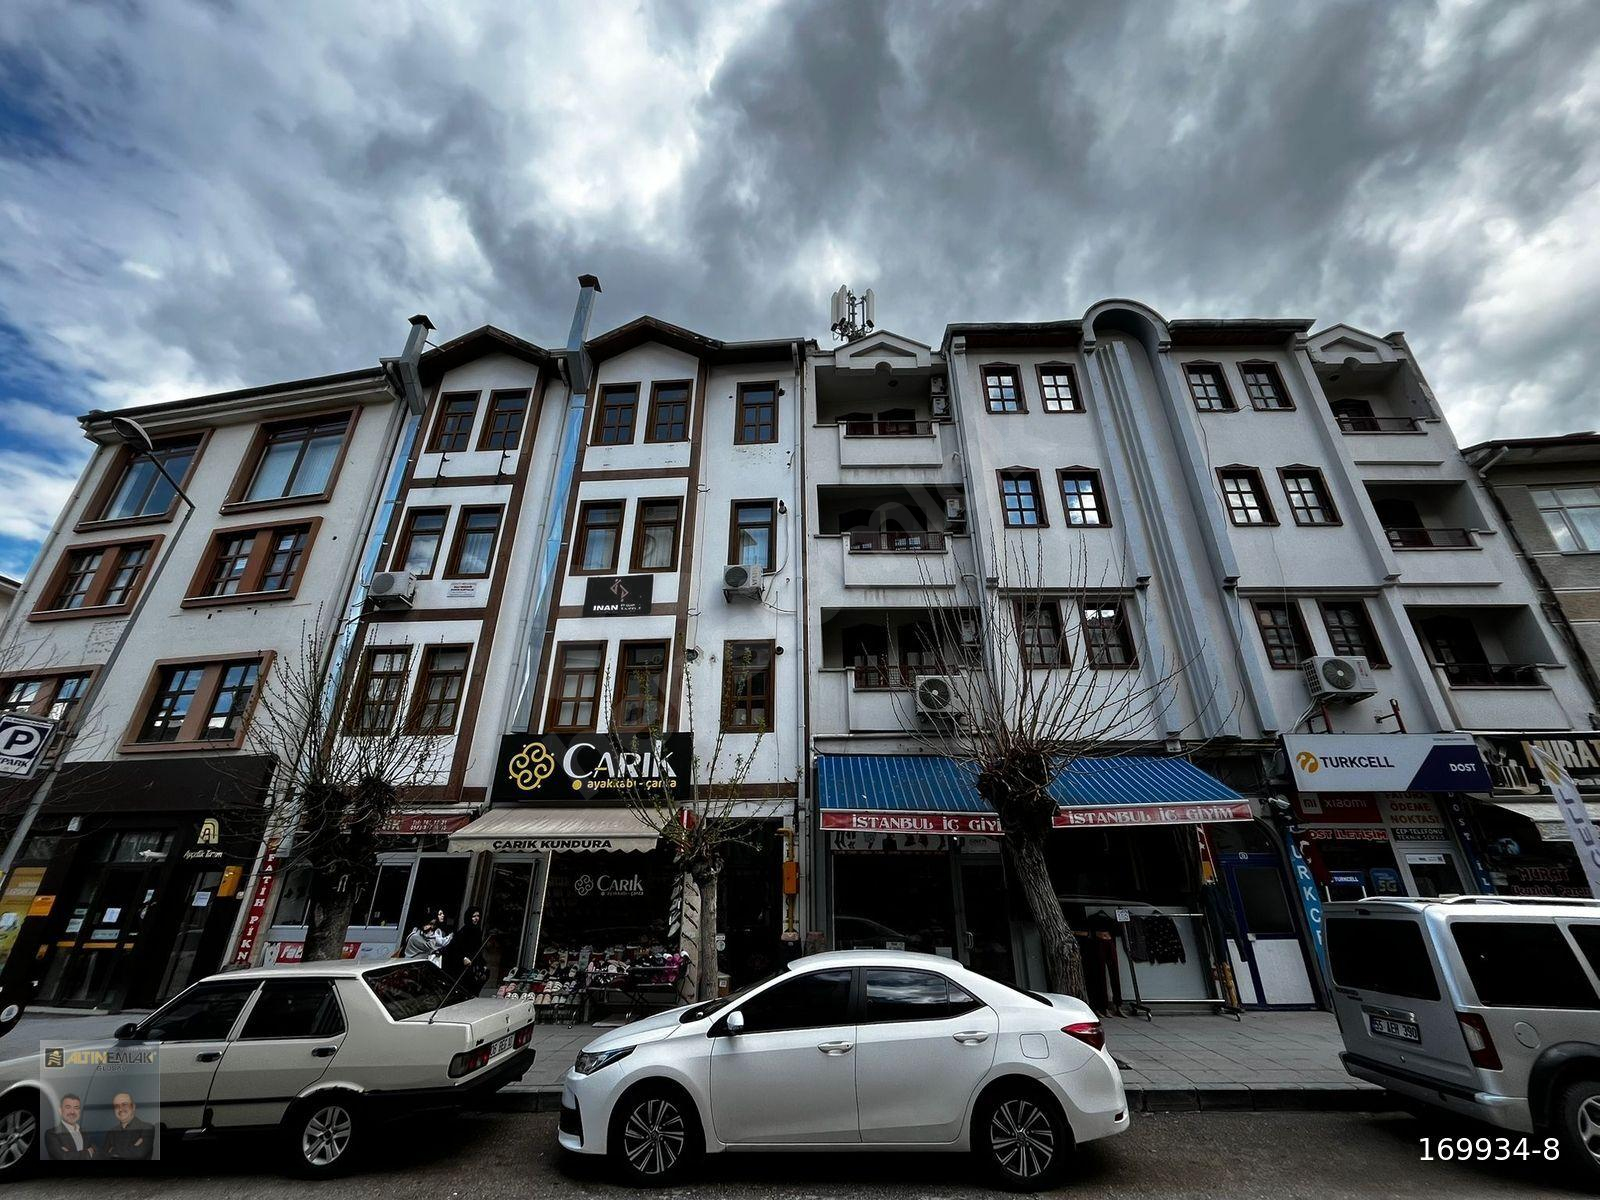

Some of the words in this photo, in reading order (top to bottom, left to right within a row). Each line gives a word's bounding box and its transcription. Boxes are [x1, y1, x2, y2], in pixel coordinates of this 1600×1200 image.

[3, 729, 34, 750] P
[0, 757, 27, 767] PARK
[1320, 756, 1395, 768] TURKCELL
[1449, 763, 1476, 772] DOST
[646, 780, 677, 790] çana
[1068, 810, 1152, 825] İSTANBUL
[1186, 806, 1233, 820] GİYİM
[1390, 815, 1440, 824] NOKTASI
[852, 814, 934, 830] İSTANBUL
[942, 816, 959, 833] İÇ
[968, 815, 1002, 832] GİYİ
[492, 840, 538, 850] ÇARIK
[541, 840, 612, 849] KUNDURA
